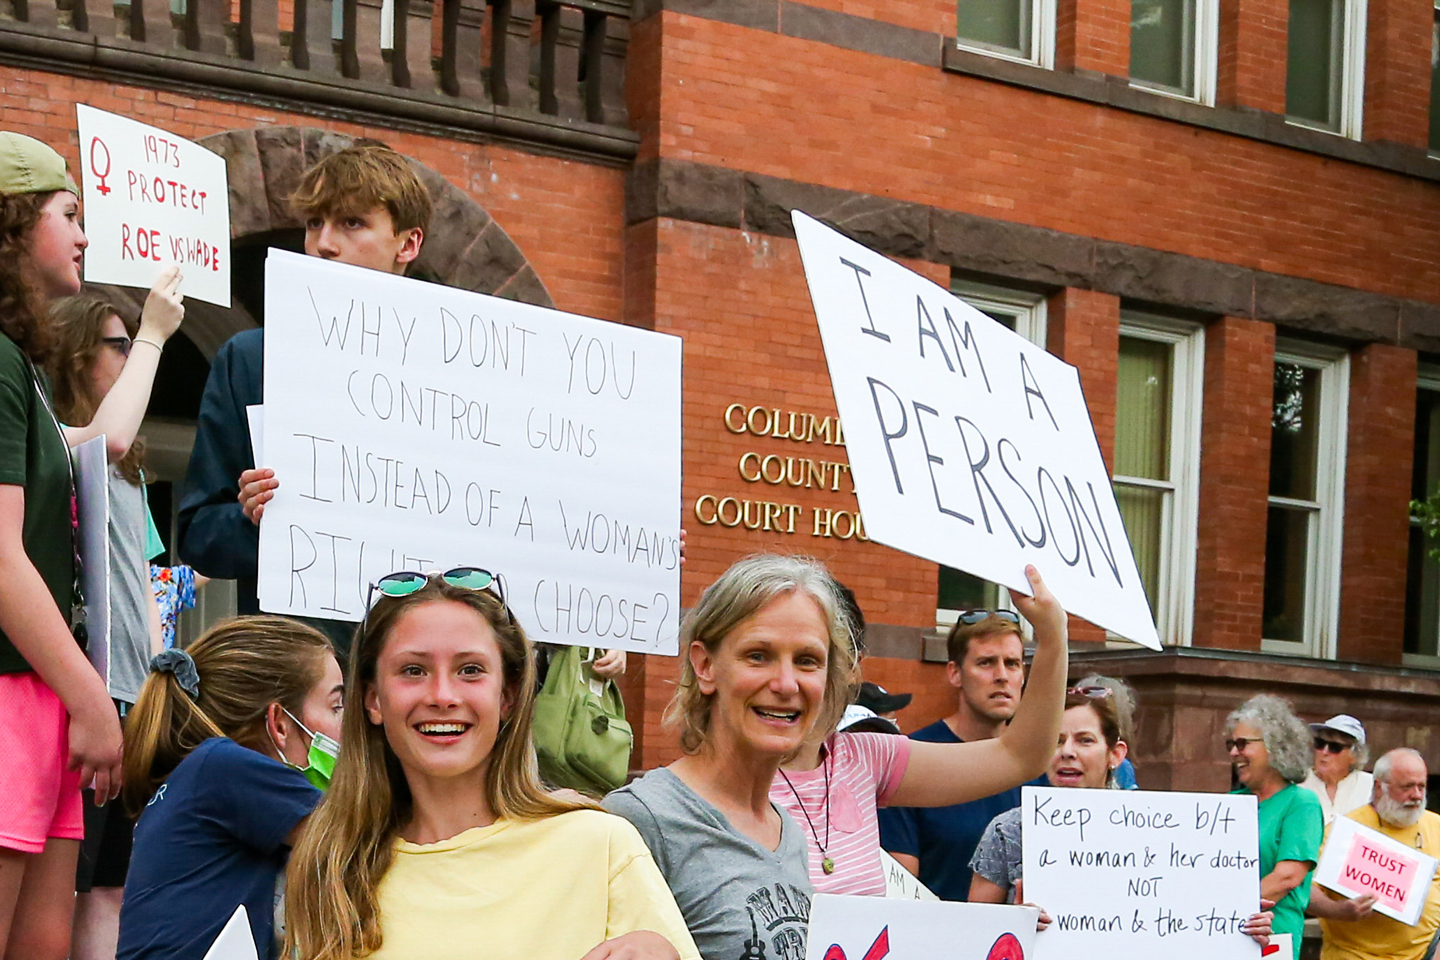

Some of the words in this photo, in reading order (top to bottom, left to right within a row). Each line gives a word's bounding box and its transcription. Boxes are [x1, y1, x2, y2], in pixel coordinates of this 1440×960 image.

[144, 134, 180, 168] 1973
[127, 170, 207, 215] PROTECT
[122, 223, 161, 261] ROE
[307, 286, 416, 366] WHY
[440, 306, 537, 377] DON'T
[563, 331, 636, 400] YOU
[839, 256, 891, 343] I
[916, 294, 992, 394] AM
[1020, 352, 1060, 431] A
[348, 369, 501, 447] CONTROL
[527, 407, 597, 458] GUNS
[739, 451, 857, 494] COUNT
[866, 376, 1124, 589] PERSON
[293, 433, 452, 514] INSTEAD
[465, 481, 502, 528] OF
[514, 496, 535, 542] A
[559, 499, 679, 570] WOMAN'S
[695, 494, 802, 533] COURT
[534, 579, 670, 648] CHOOSE?
[1034, 795, 1091, 841] Keep
[1109, 804, 1180, 828] choice
[1195, 802, 1236, 835] b/t
[1039, 849, 1057, 867] a
[1069, 849, 1136, 868] woman
[1144, 847, 1157, 865] &
[1169, 843, 1204, 868] her
[1210, 850, 1259, 869] doctor
[1362, 845, 1407, 875] TRUST
[889, 863, 905, 894] AM
[914, 885, 921, 900] A
[1128, 877, 1163, 897] NOT
[1346, 864, 1406, 902] WOMEN
[1057, 912, 1122, 932] woman
[1132, 909, 1148, 933] &
[1155, 907, 1188, 937] the
[1194, 907, 1246, 936] state
